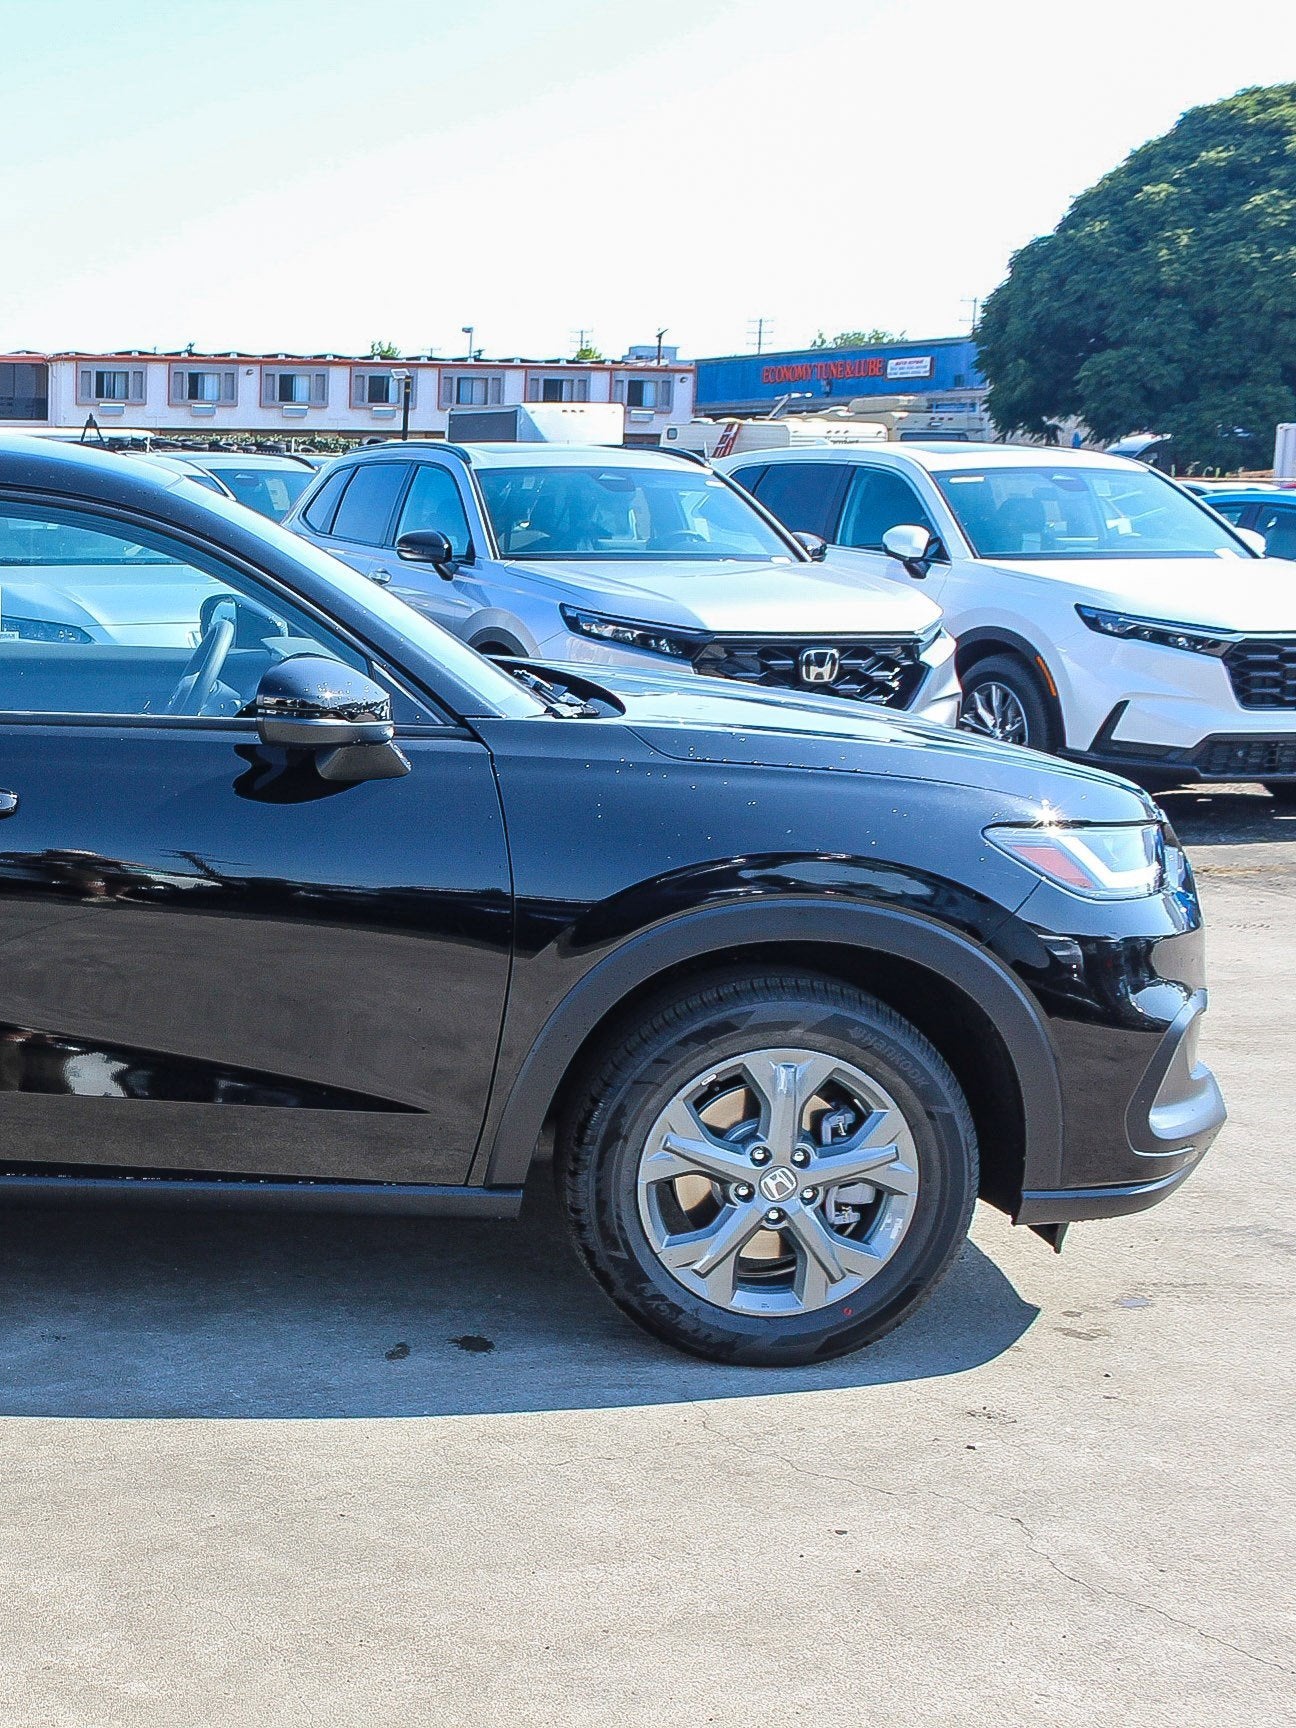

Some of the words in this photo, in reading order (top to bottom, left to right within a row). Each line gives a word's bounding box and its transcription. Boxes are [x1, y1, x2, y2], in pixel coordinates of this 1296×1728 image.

[763, 364, 812, 383] ECONOMY
[815, 362, 844, 380] TUNE
[854, 359, 884, 378] LUBE
